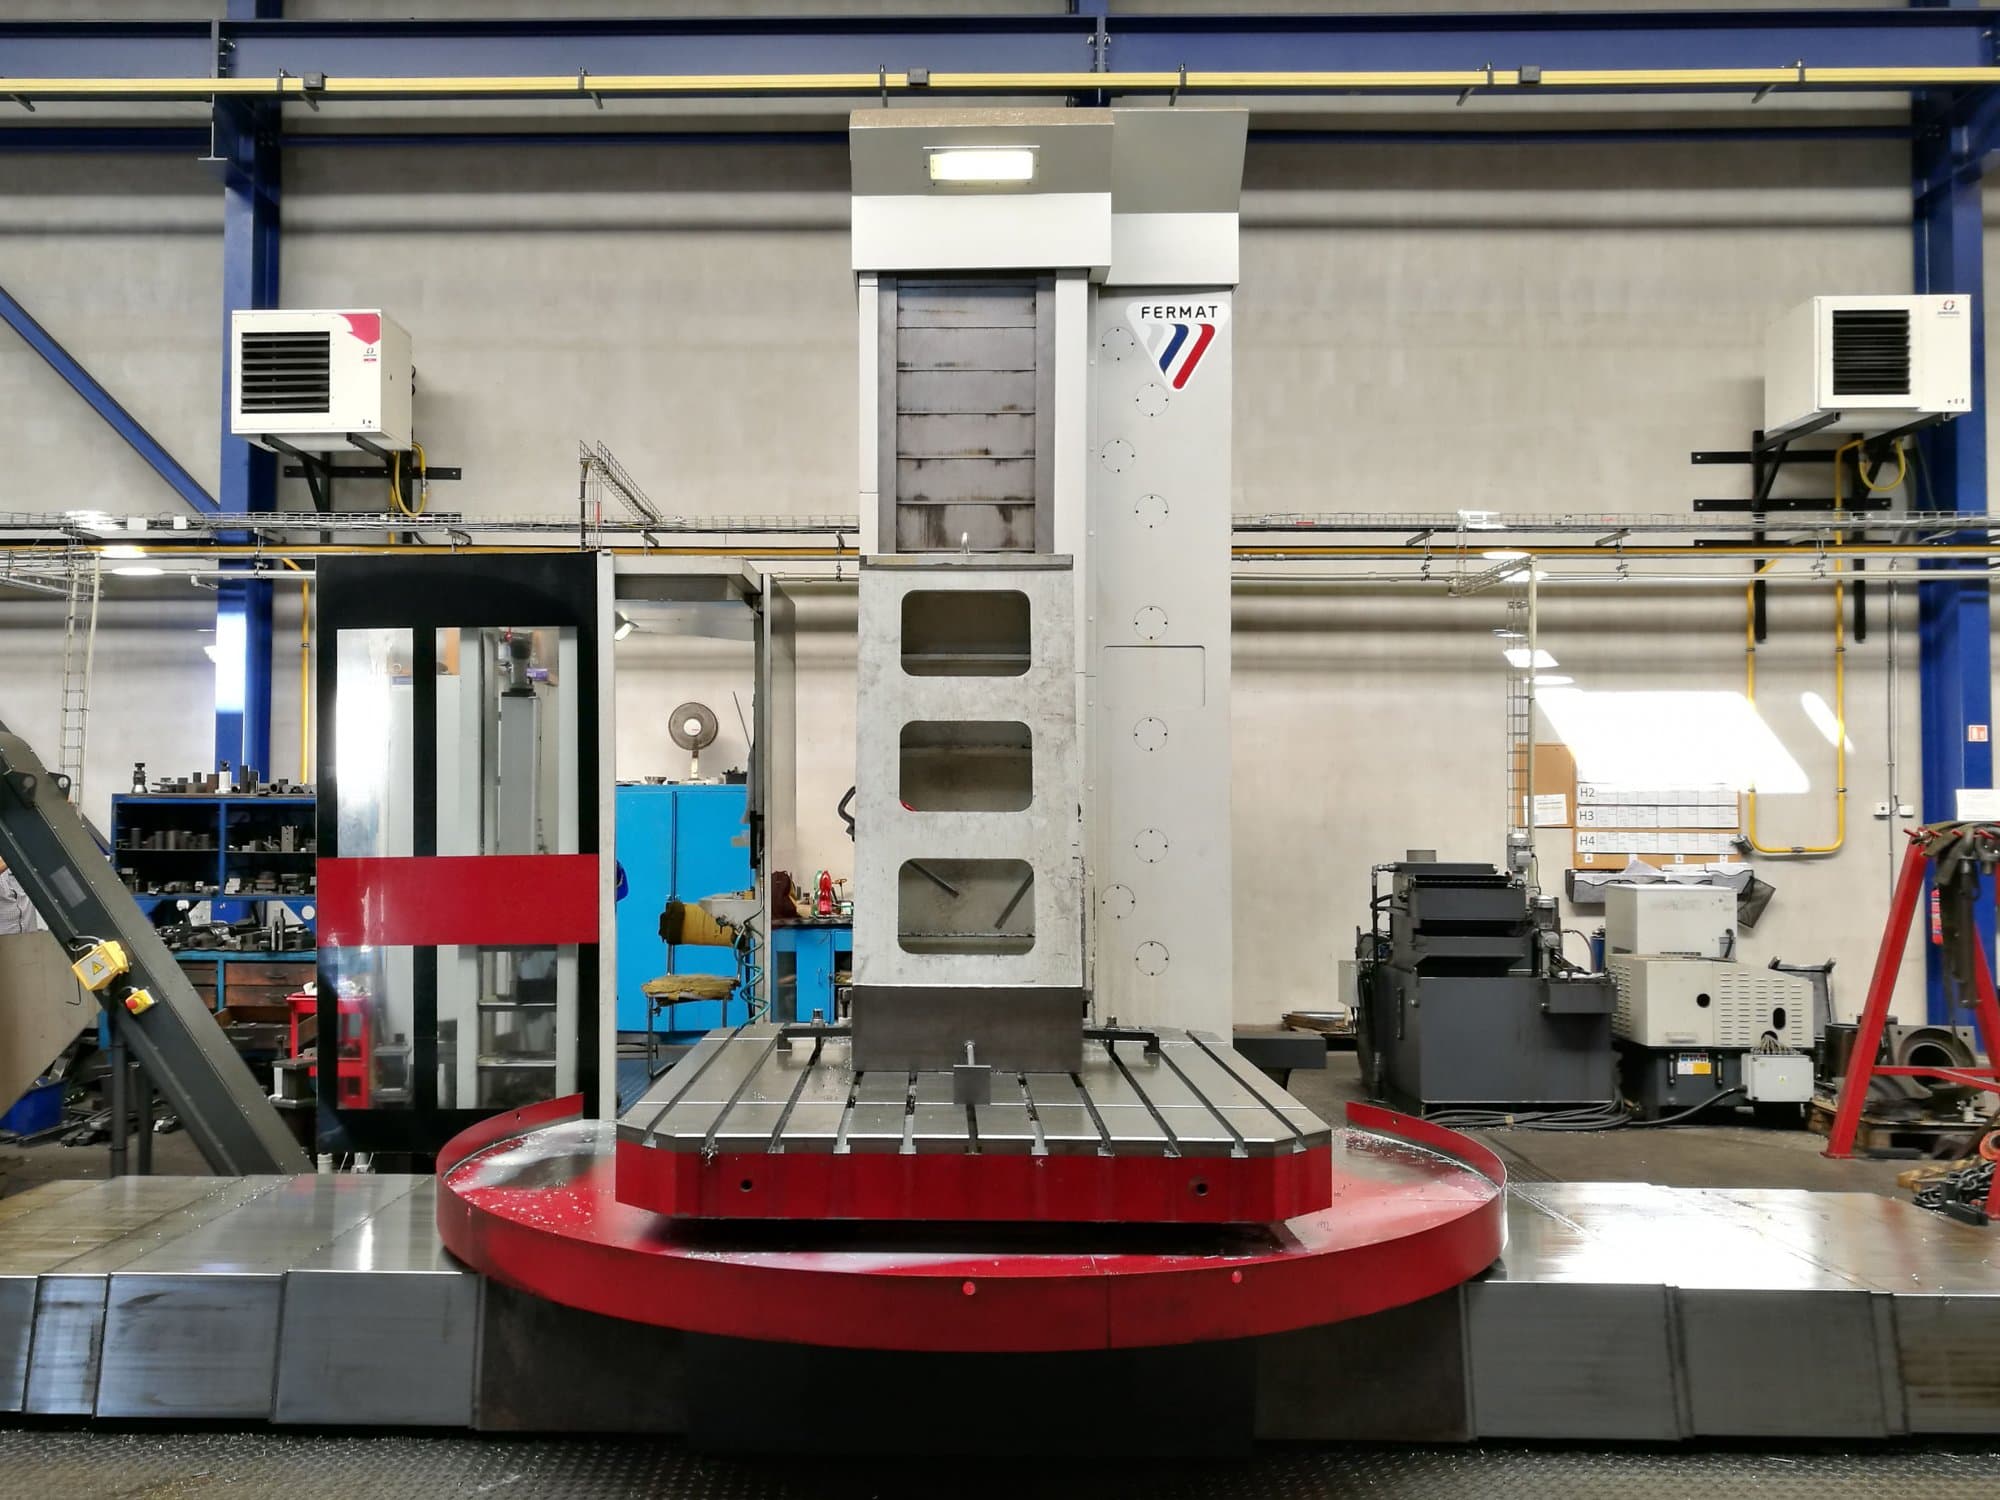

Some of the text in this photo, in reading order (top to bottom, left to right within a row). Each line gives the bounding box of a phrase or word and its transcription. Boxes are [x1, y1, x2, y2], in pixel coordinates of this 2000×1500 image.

[1141, 305, 1218, 319] FERMAT
[1580, 787, 1595, 798] H2
[1579, 810, 1594, 821] H3
[1580, 835, 1595, 846] H4
